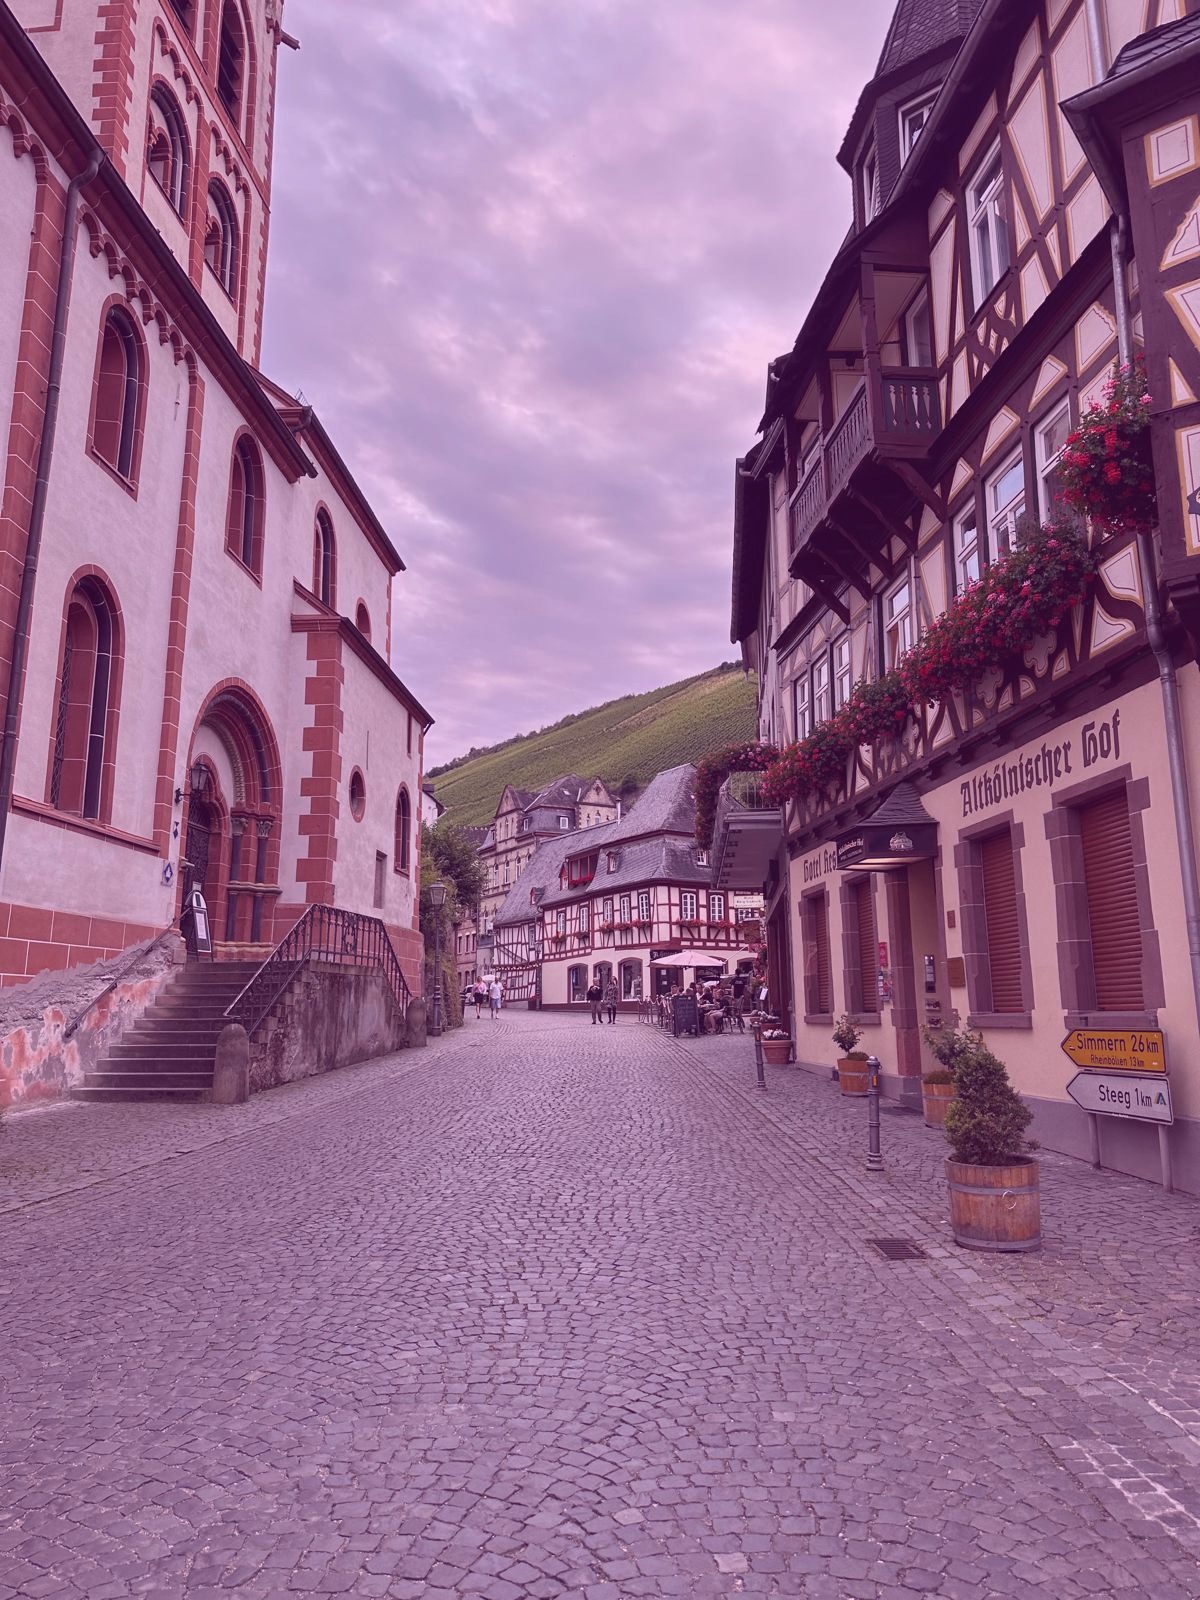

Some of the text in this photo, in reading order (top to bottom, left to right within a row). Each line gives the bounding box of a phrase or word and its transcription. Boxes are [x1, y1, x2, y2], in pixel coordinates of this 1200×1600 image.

[960, 708, 1120, 817] Altkölnischer Hof
[803, 853, 822, 883] Hotel
[1076, 1033, 1159, 1053] Simmern 26 km
[1098, 1084, 1131, 1109] Steeg
